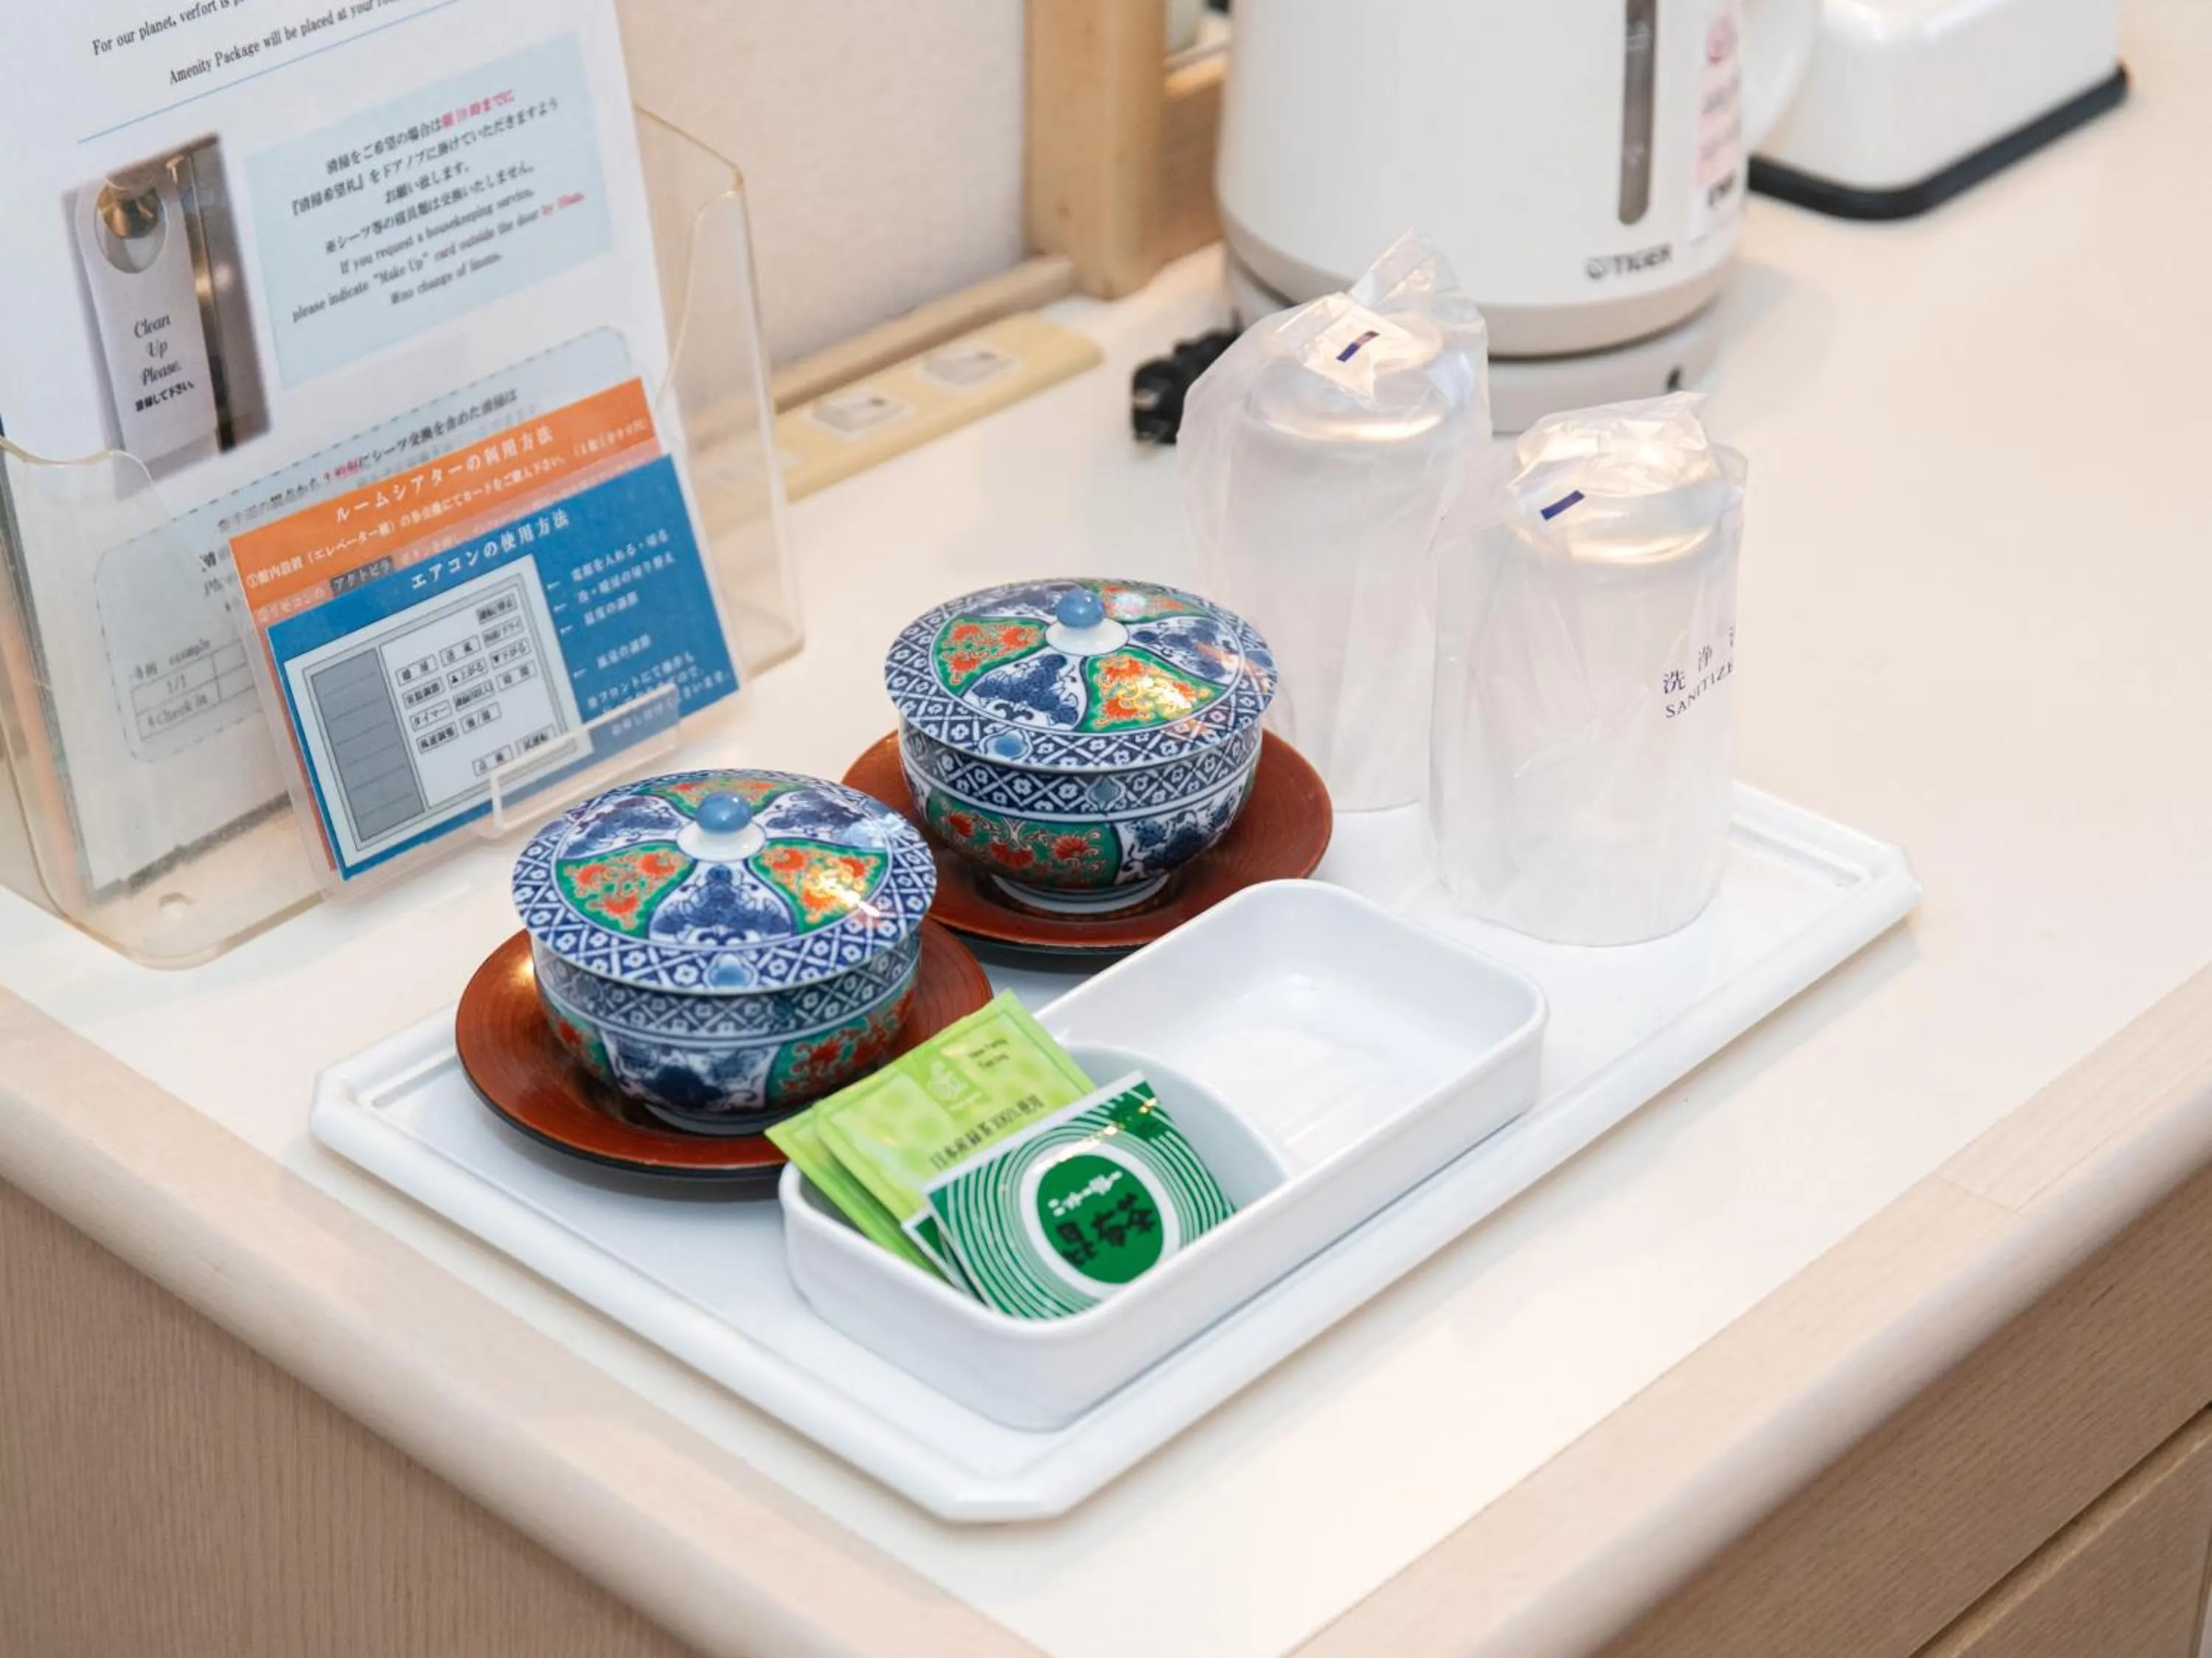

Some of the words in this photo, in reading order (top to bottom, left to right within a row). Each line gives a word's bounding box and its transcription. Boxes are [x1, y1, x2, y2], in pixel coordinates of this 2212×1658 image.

[92, 38, 112, 55] For
[116, 31, 136, 47] our
[169, 58, 212, 84] Amenity
[215, 41, 260, 67] Package
[263, 30, 282, 48] will
[284, 27, 297, 41] be
[299, 9, 334, 37] placed
[338, 6, 347, 21] at
[340, 260, 349, 274] If
[354, 254, 373, 271] you
[375, 235, 414, 260] request
[417, 233, 423, 243] a
[425, 204, 493, 240] housekeeping
[292, 299, 326, 323] please
[329, 281, 369, 306] indicate
[498, 221, 514, 235] the
[1613, 243, 1673, 275] TIGER
[417, 274, 453, 294] change
[456, 263, 466, 277] of
[133, 314, 171, 339] Clean
[147, 340, 168, 358] Up
[411, 508, 569, 590] エアコンの使用方法
